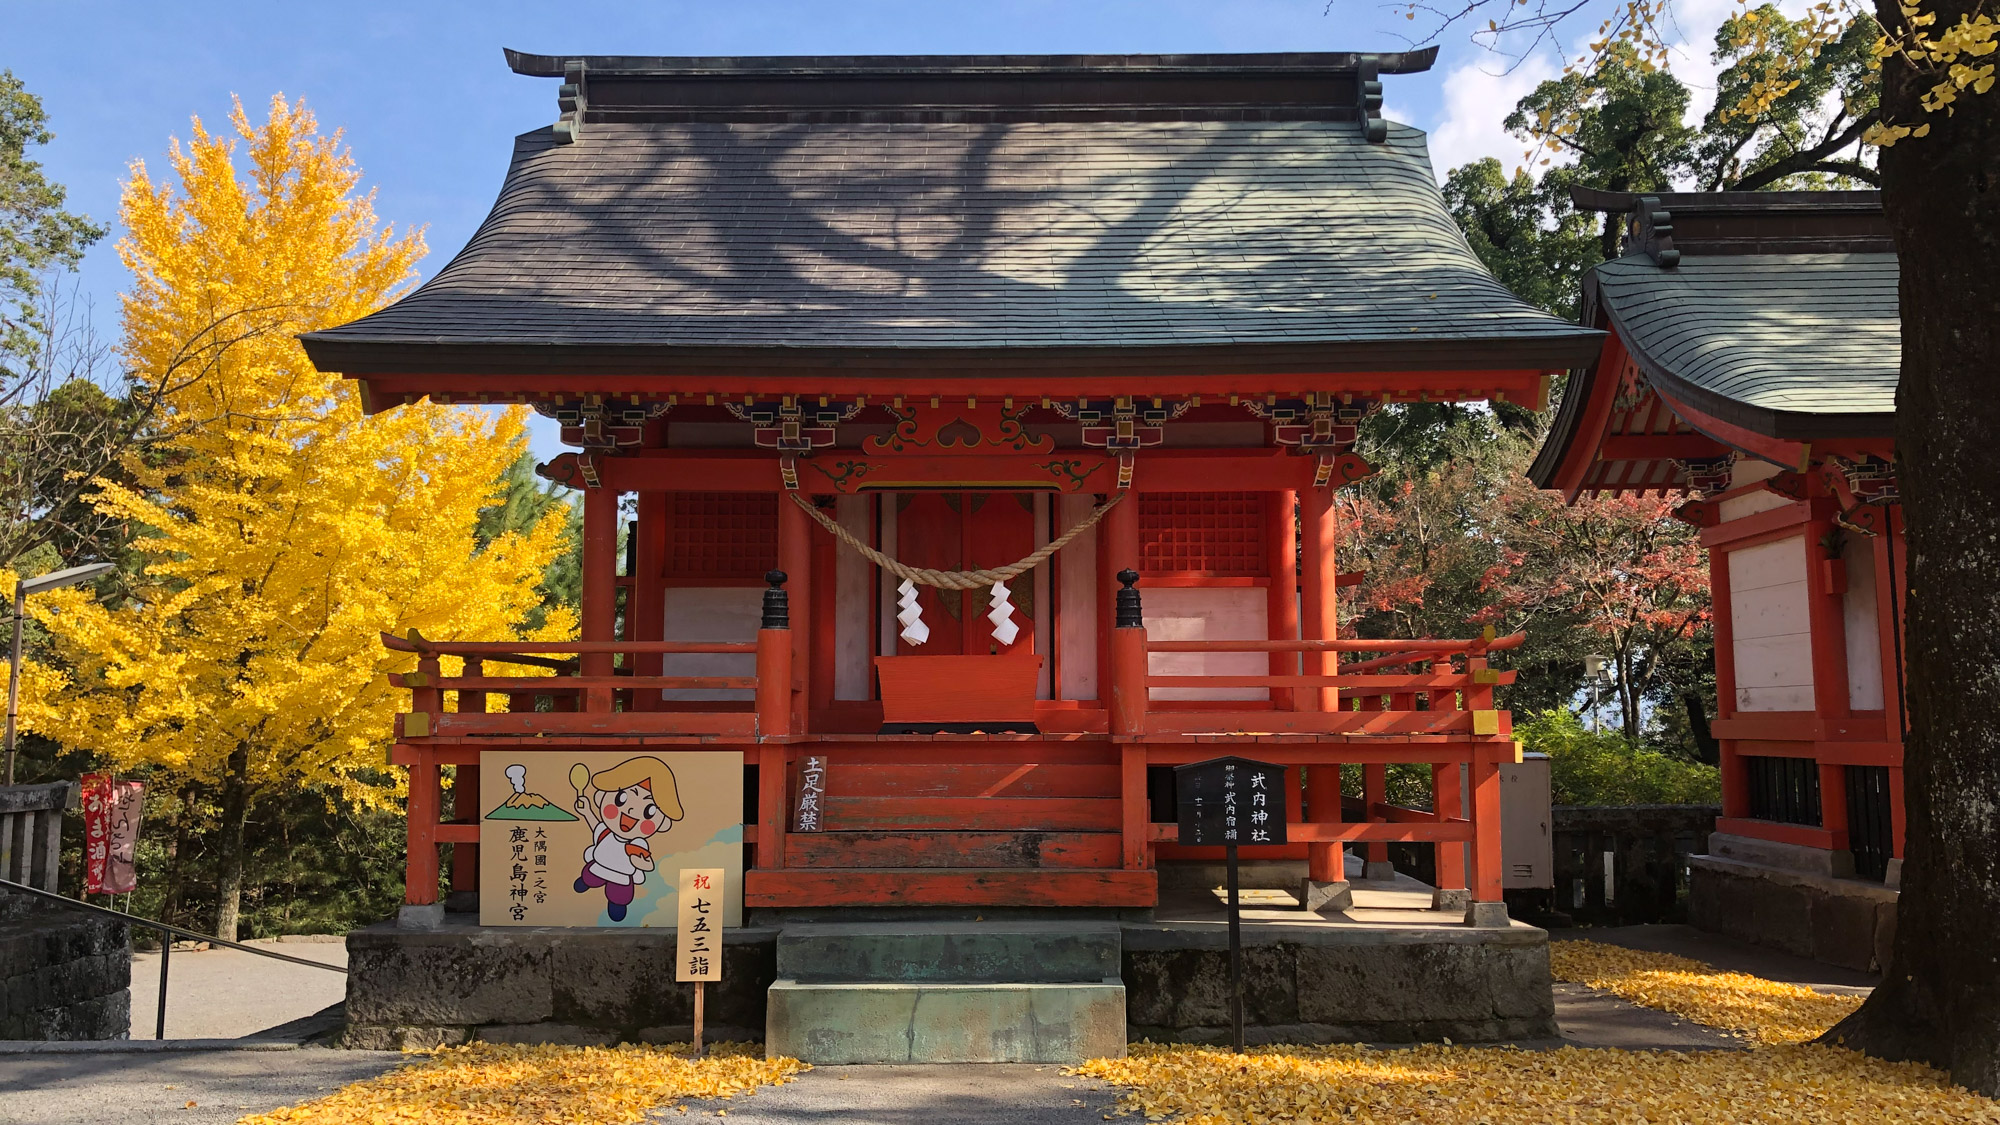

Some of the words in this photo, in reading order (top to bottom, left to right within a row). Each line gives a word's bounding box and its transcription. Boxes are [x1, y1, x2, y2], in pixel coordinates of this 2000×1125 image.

[798, 756, 824, 831] 土足厳禁
[1250, 772, 1271, 842] 武内神社
[508, 825, 529, 921] 鹿児島神宮
[533, 826, 548, 904] 大隅國一之宮
[693, 873, 711, 890] 祝
[688, 898, 712, 976] 七五三詣
